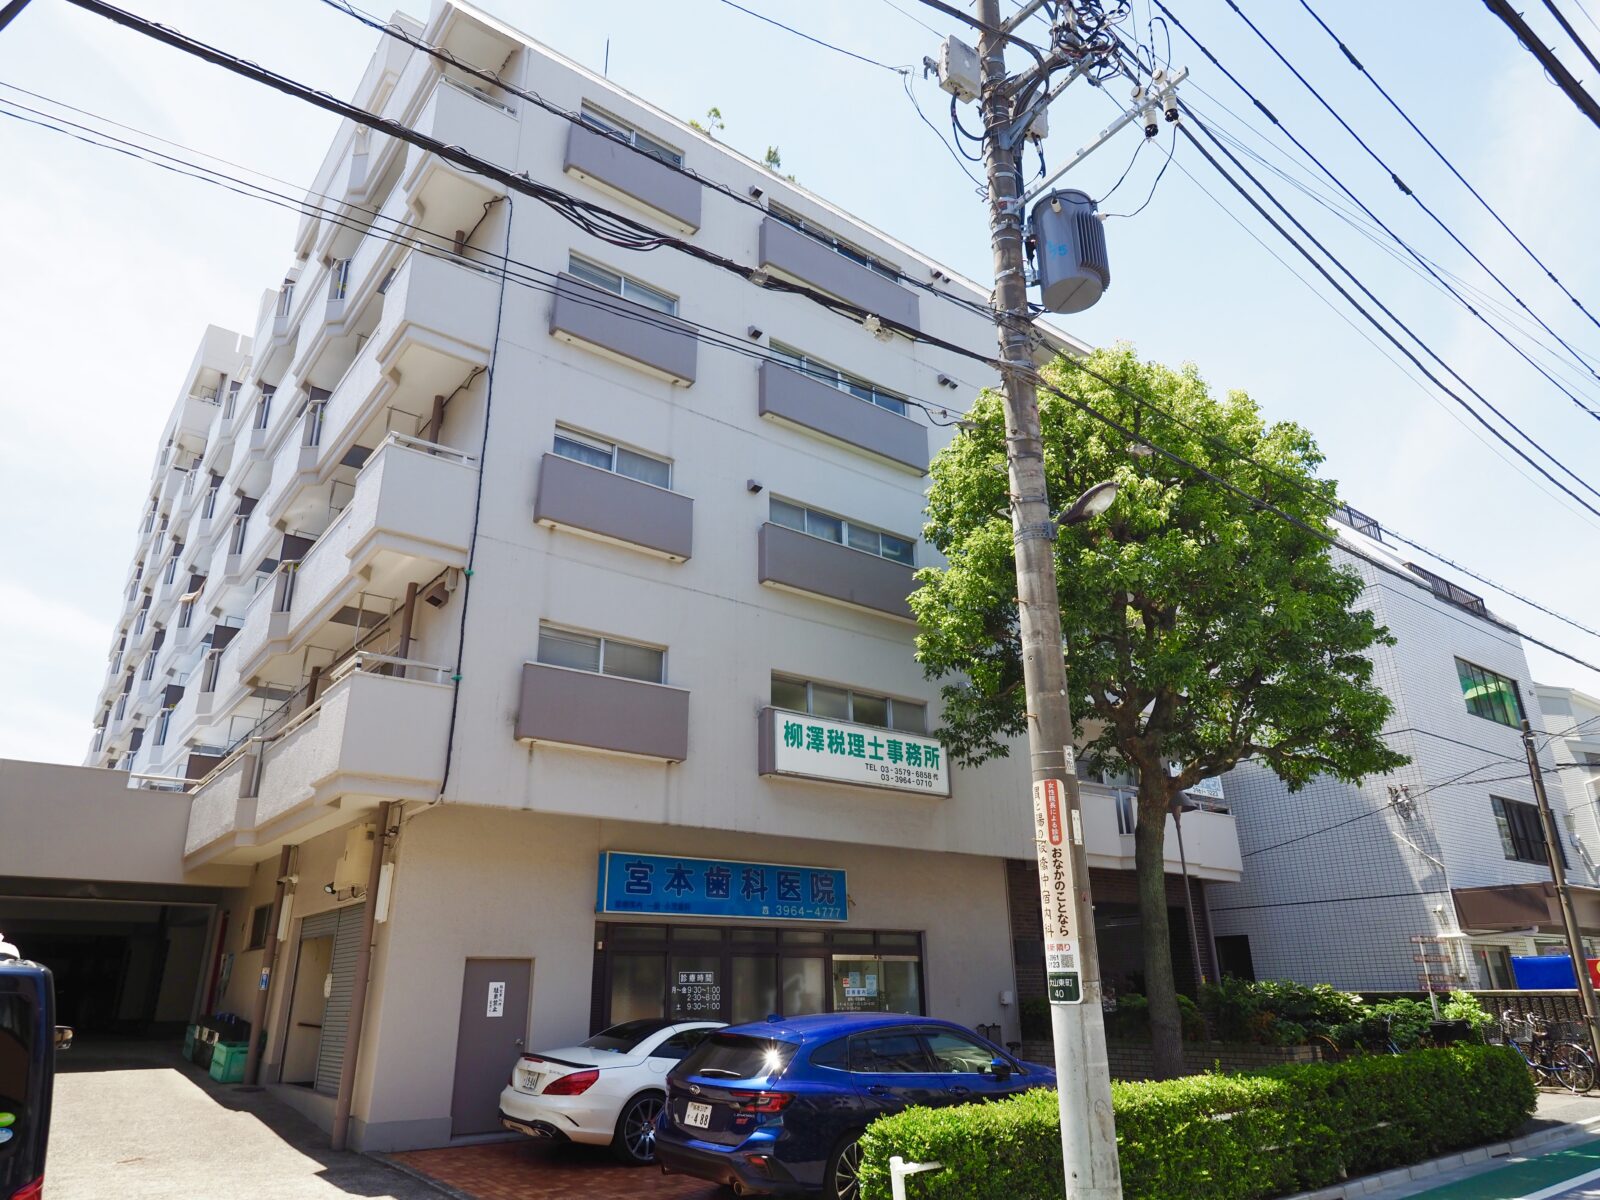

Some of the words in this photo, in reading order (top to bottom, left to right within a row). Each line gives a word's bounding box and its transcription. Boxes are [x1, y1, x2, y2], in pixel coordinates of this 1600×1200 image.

[783, 719, 940, 771] 柳澤税理士事務所
[865, 762, 878, 772] TEL
[880, 765, 932, 780] 03-3579-6858
[880, 773, 933, 788] 03-3964-0710
[624, 859, 836, 905] 宮本歯科医院
[1052, 847, 1069, 937] おなかのことなら
[775, 904, 841, 918] 3964-4777
[680, 973, 712, 983] 診療時間
[1054, 989, 1065, 998] 40
